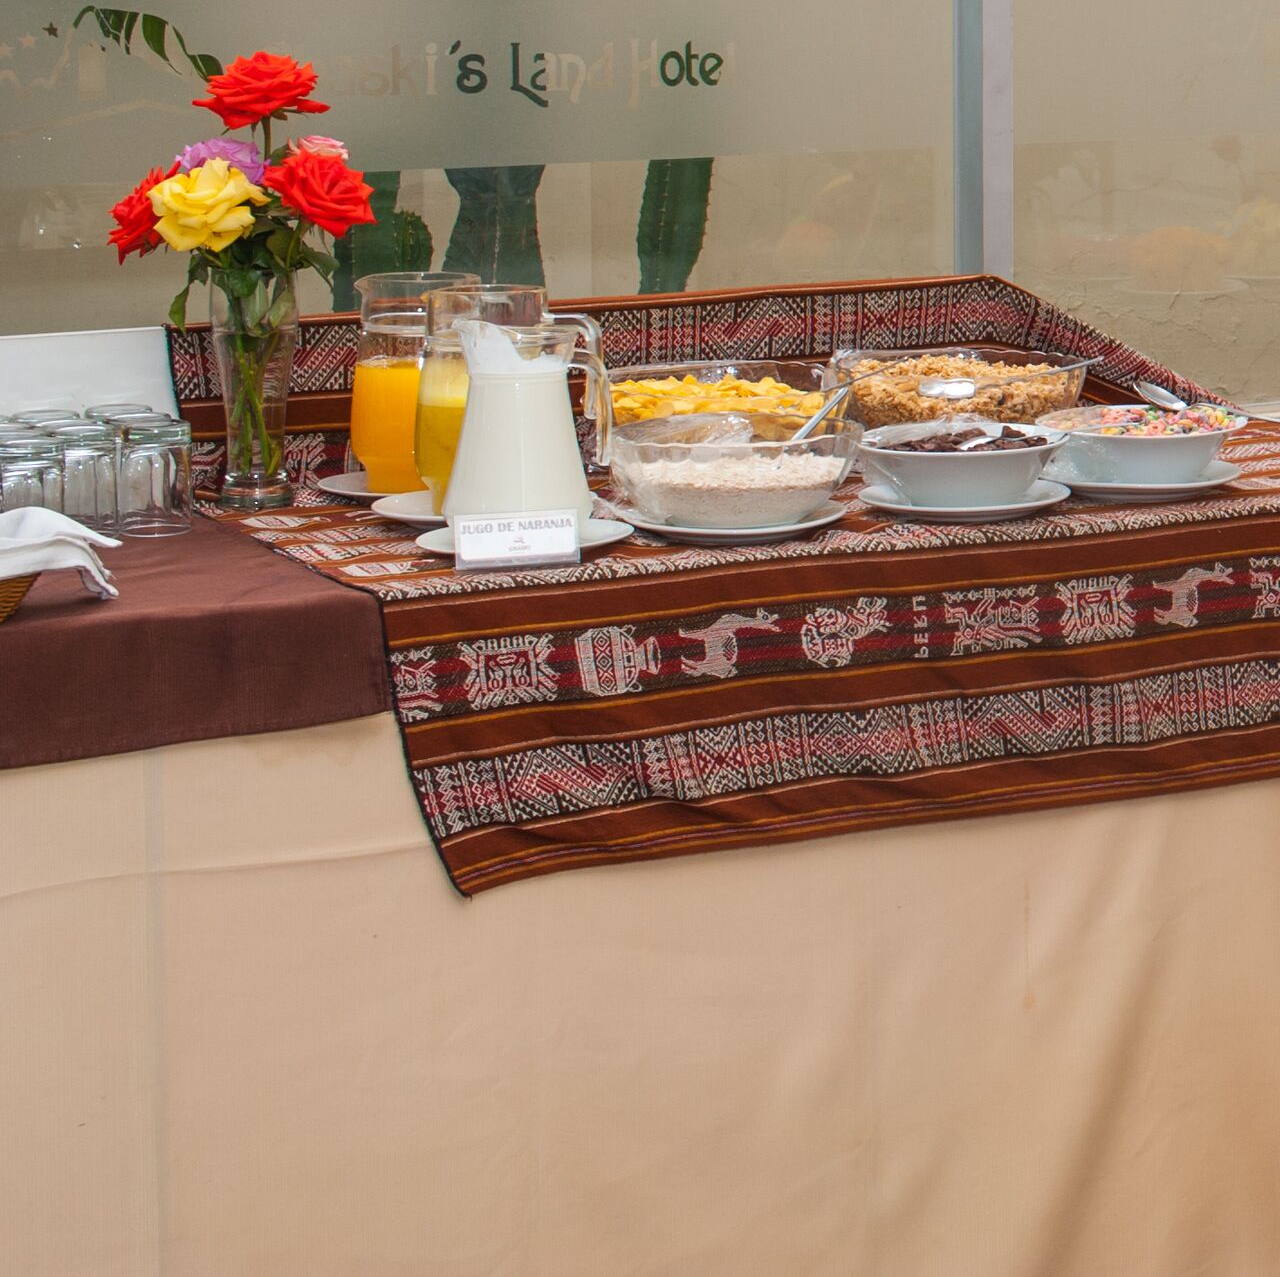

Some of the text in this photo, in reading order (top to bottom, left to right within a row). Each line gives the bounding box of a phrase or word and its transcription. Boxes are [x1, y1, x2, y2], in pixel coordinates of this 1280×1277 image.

[509, 41, 614, 109] Land
[625, 37, 737, 112] Hotel
[461, 517, 573, 535] JUGO DE NARANJA
